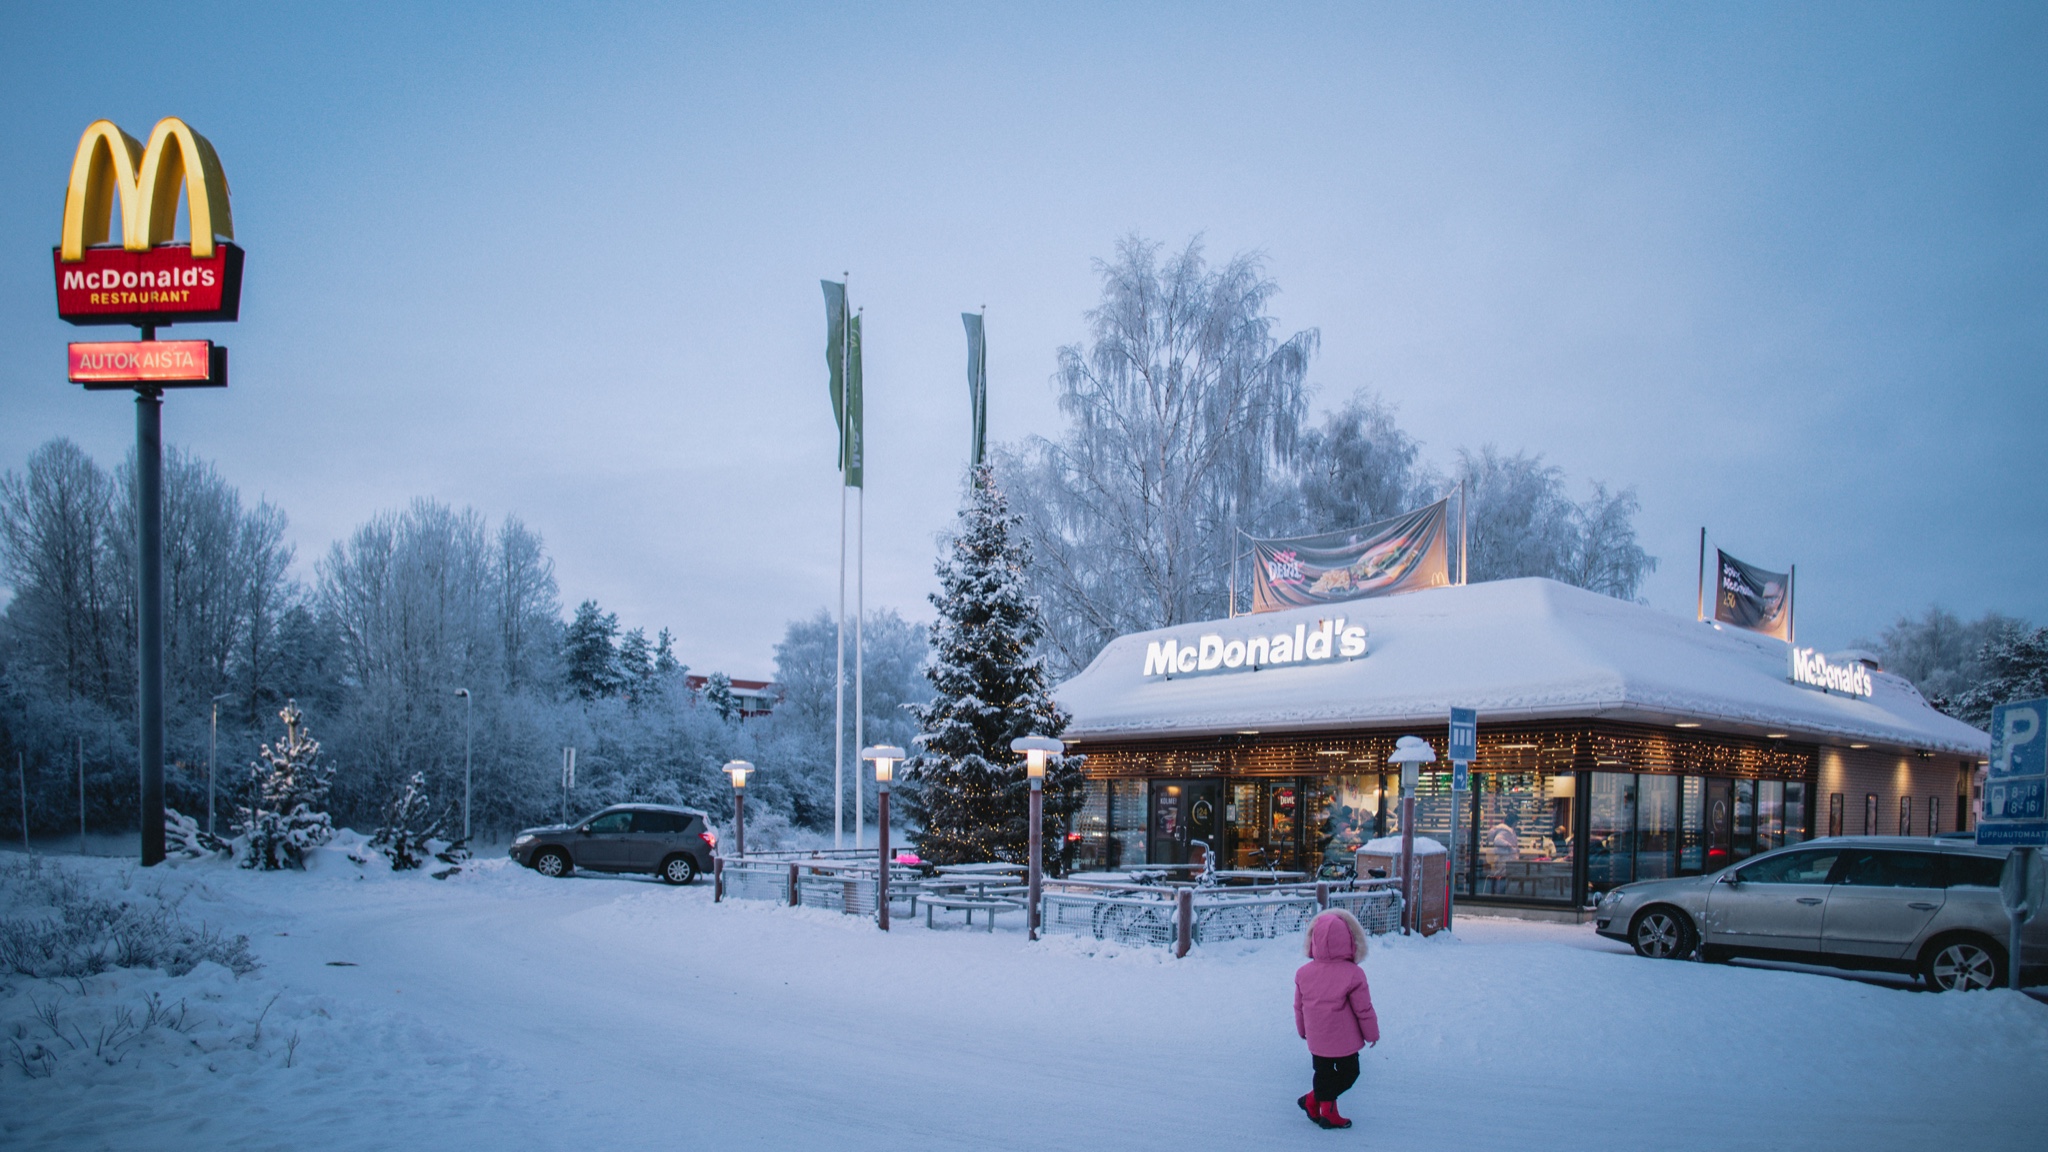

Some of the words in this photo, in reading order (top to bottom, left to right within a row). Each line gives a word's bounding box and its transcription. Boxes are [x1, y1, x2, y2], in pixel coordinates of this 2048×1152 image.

[63, 266, 215, 291] McDonald's
[90, 290, 190, 305] RESTAURANT
[79, 351, 194, 370] AUTOKAISTA
[1143, 618, 1366, 676] McDonald's
[1793, 648, 1872, 698] McDonald's
[2001, 707, 2039, 772] P
